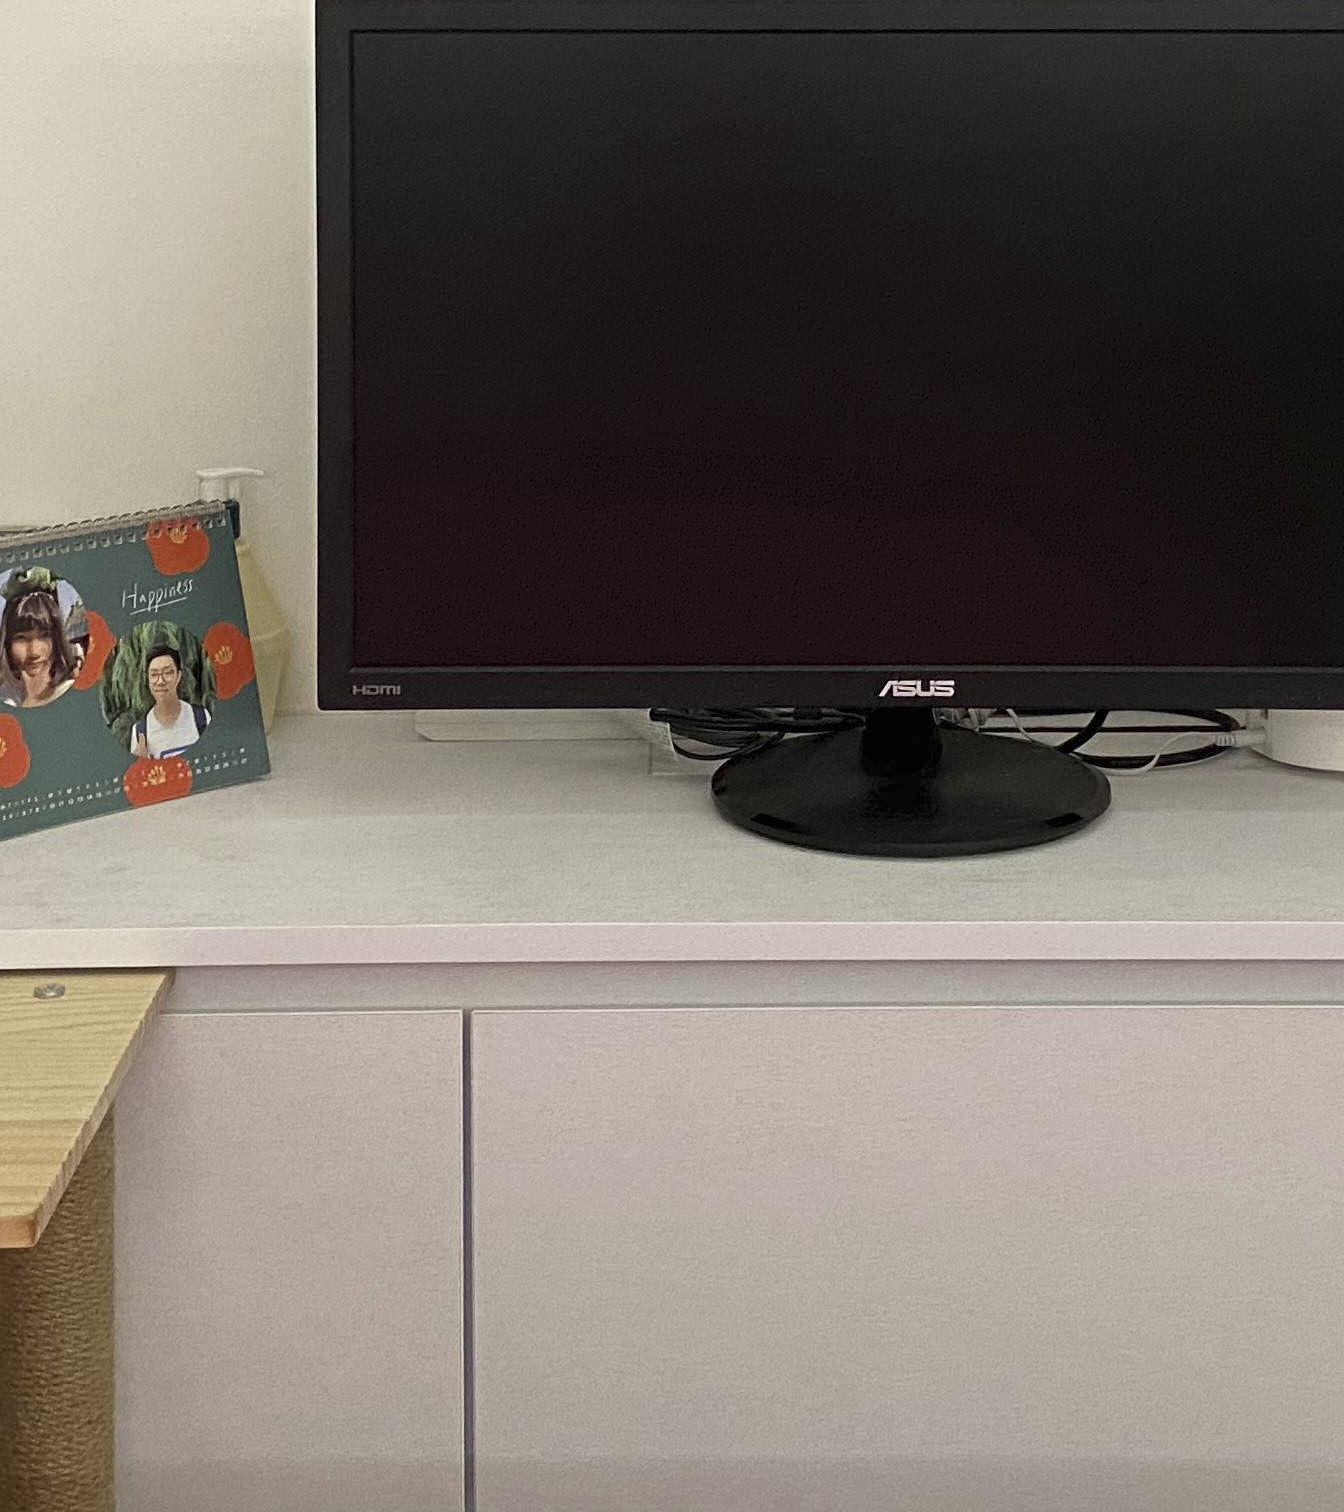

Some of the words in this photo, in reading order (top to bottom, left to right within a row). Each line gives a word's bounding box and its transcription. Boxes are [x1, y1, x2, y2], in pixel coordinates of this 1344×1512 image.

[121, 578, 194, 613] Happiness
[352, 685, 401, 696] HDMI
[878, 680, 955, 697] ASUS
